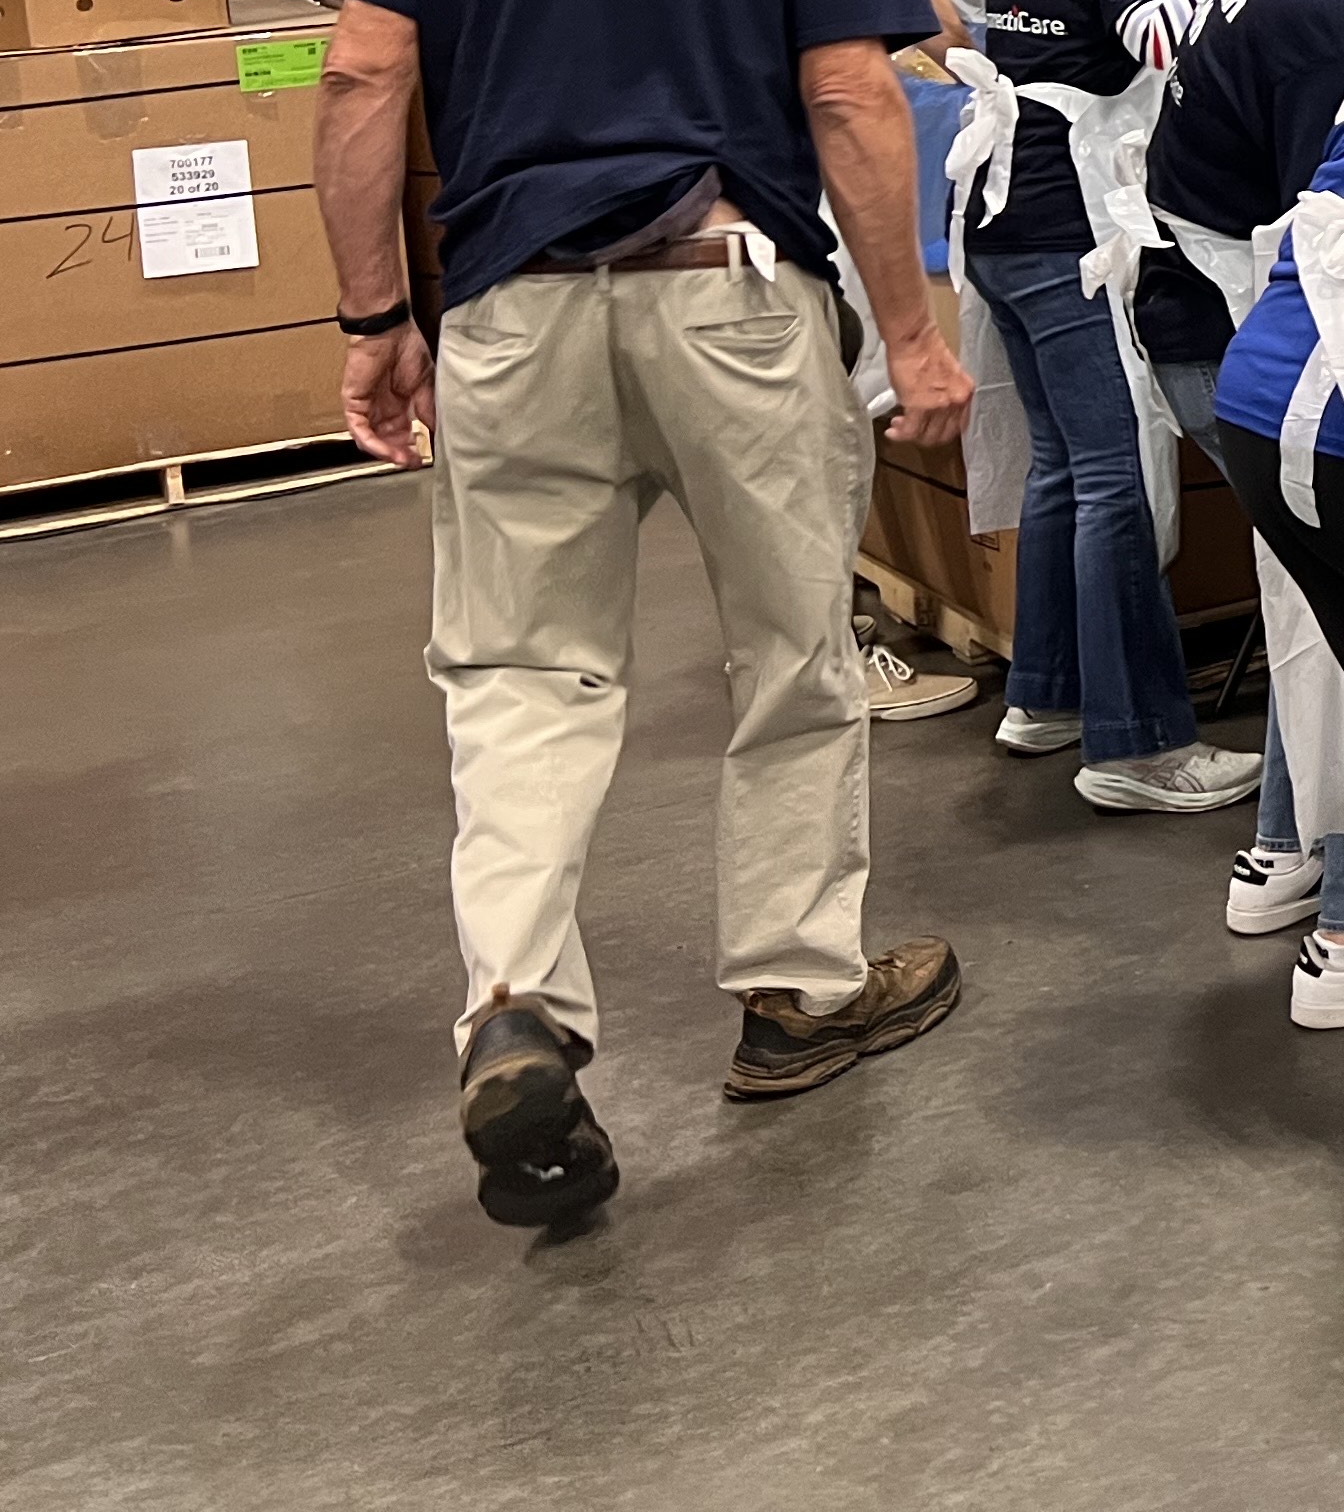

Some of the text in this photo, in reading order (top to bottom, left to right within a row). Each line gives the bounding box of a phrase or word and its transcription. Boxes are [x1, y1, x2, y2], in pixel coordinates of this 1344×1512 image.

[169, 156, 214, 169] 700177
[171, 169, 215, 182] 533929
[169, 182, 219, 195] 20 of 20
[46, 213, 135, 279] 24
